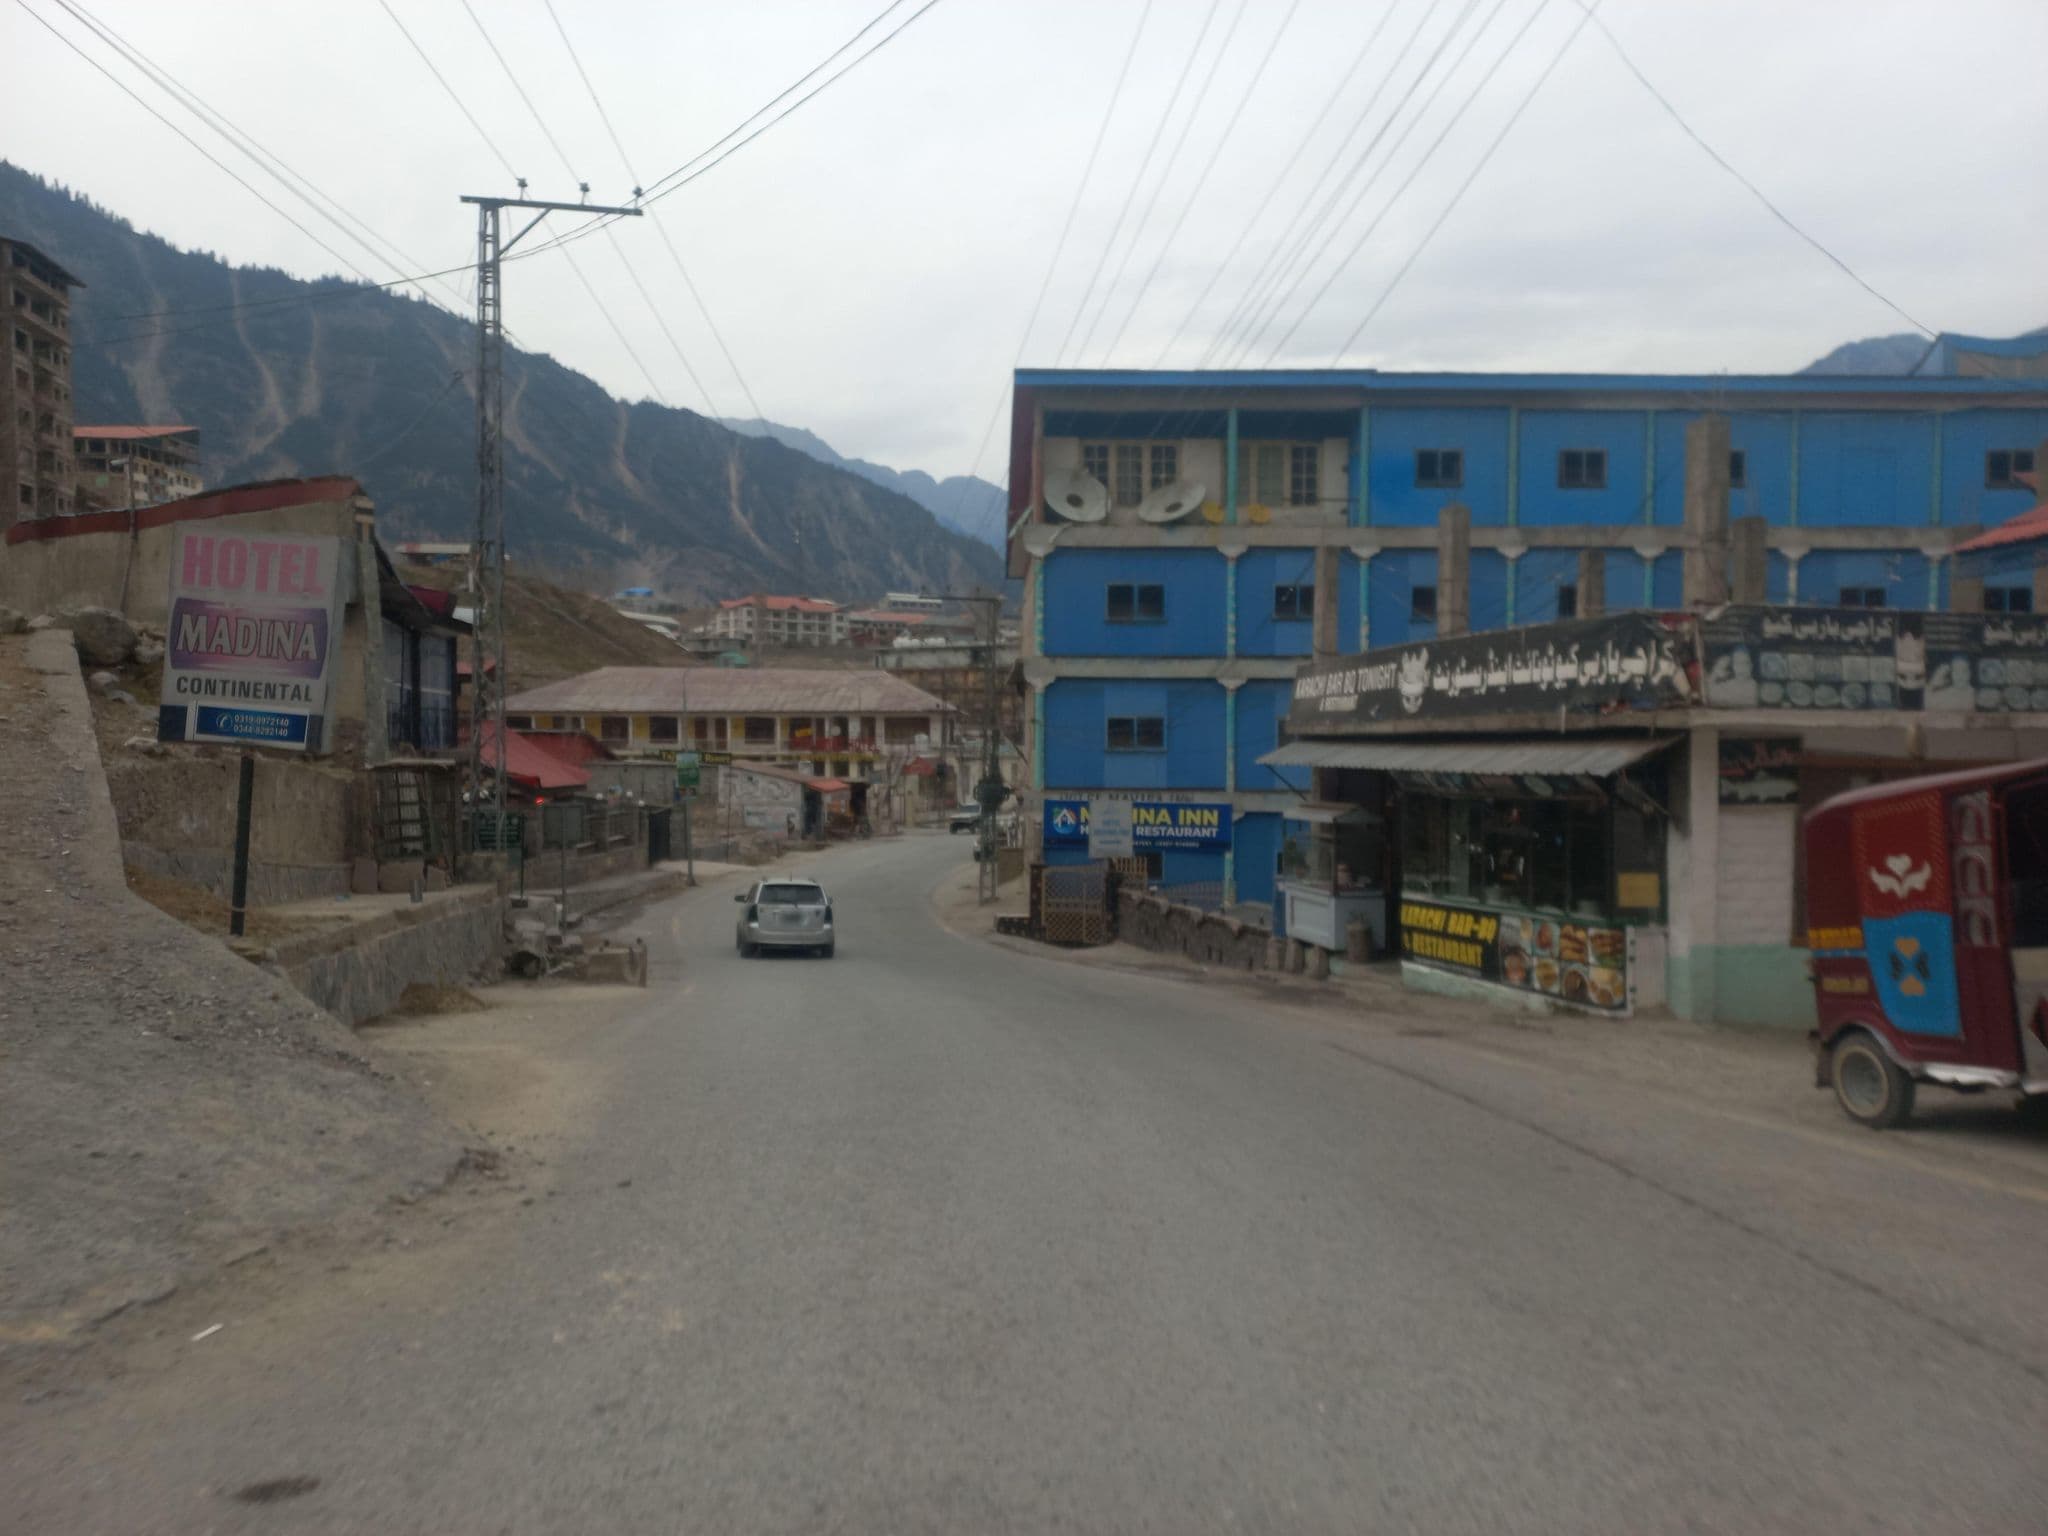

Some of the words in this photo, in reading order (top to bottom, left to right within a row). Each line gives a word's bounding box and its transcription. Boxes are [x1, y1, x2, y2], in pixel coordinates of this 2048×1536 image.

[181, 534, 326, 593] HOTEL
[175, 613, 318, 661] MADINA
[176, 676, 313, 701] CONTINENTAL
[1136, 826, 1219, 838] RESTAURANT
[1178, 808, 1219, 827] INN
[1412, 932, 1483, 968] RESTAURANT
